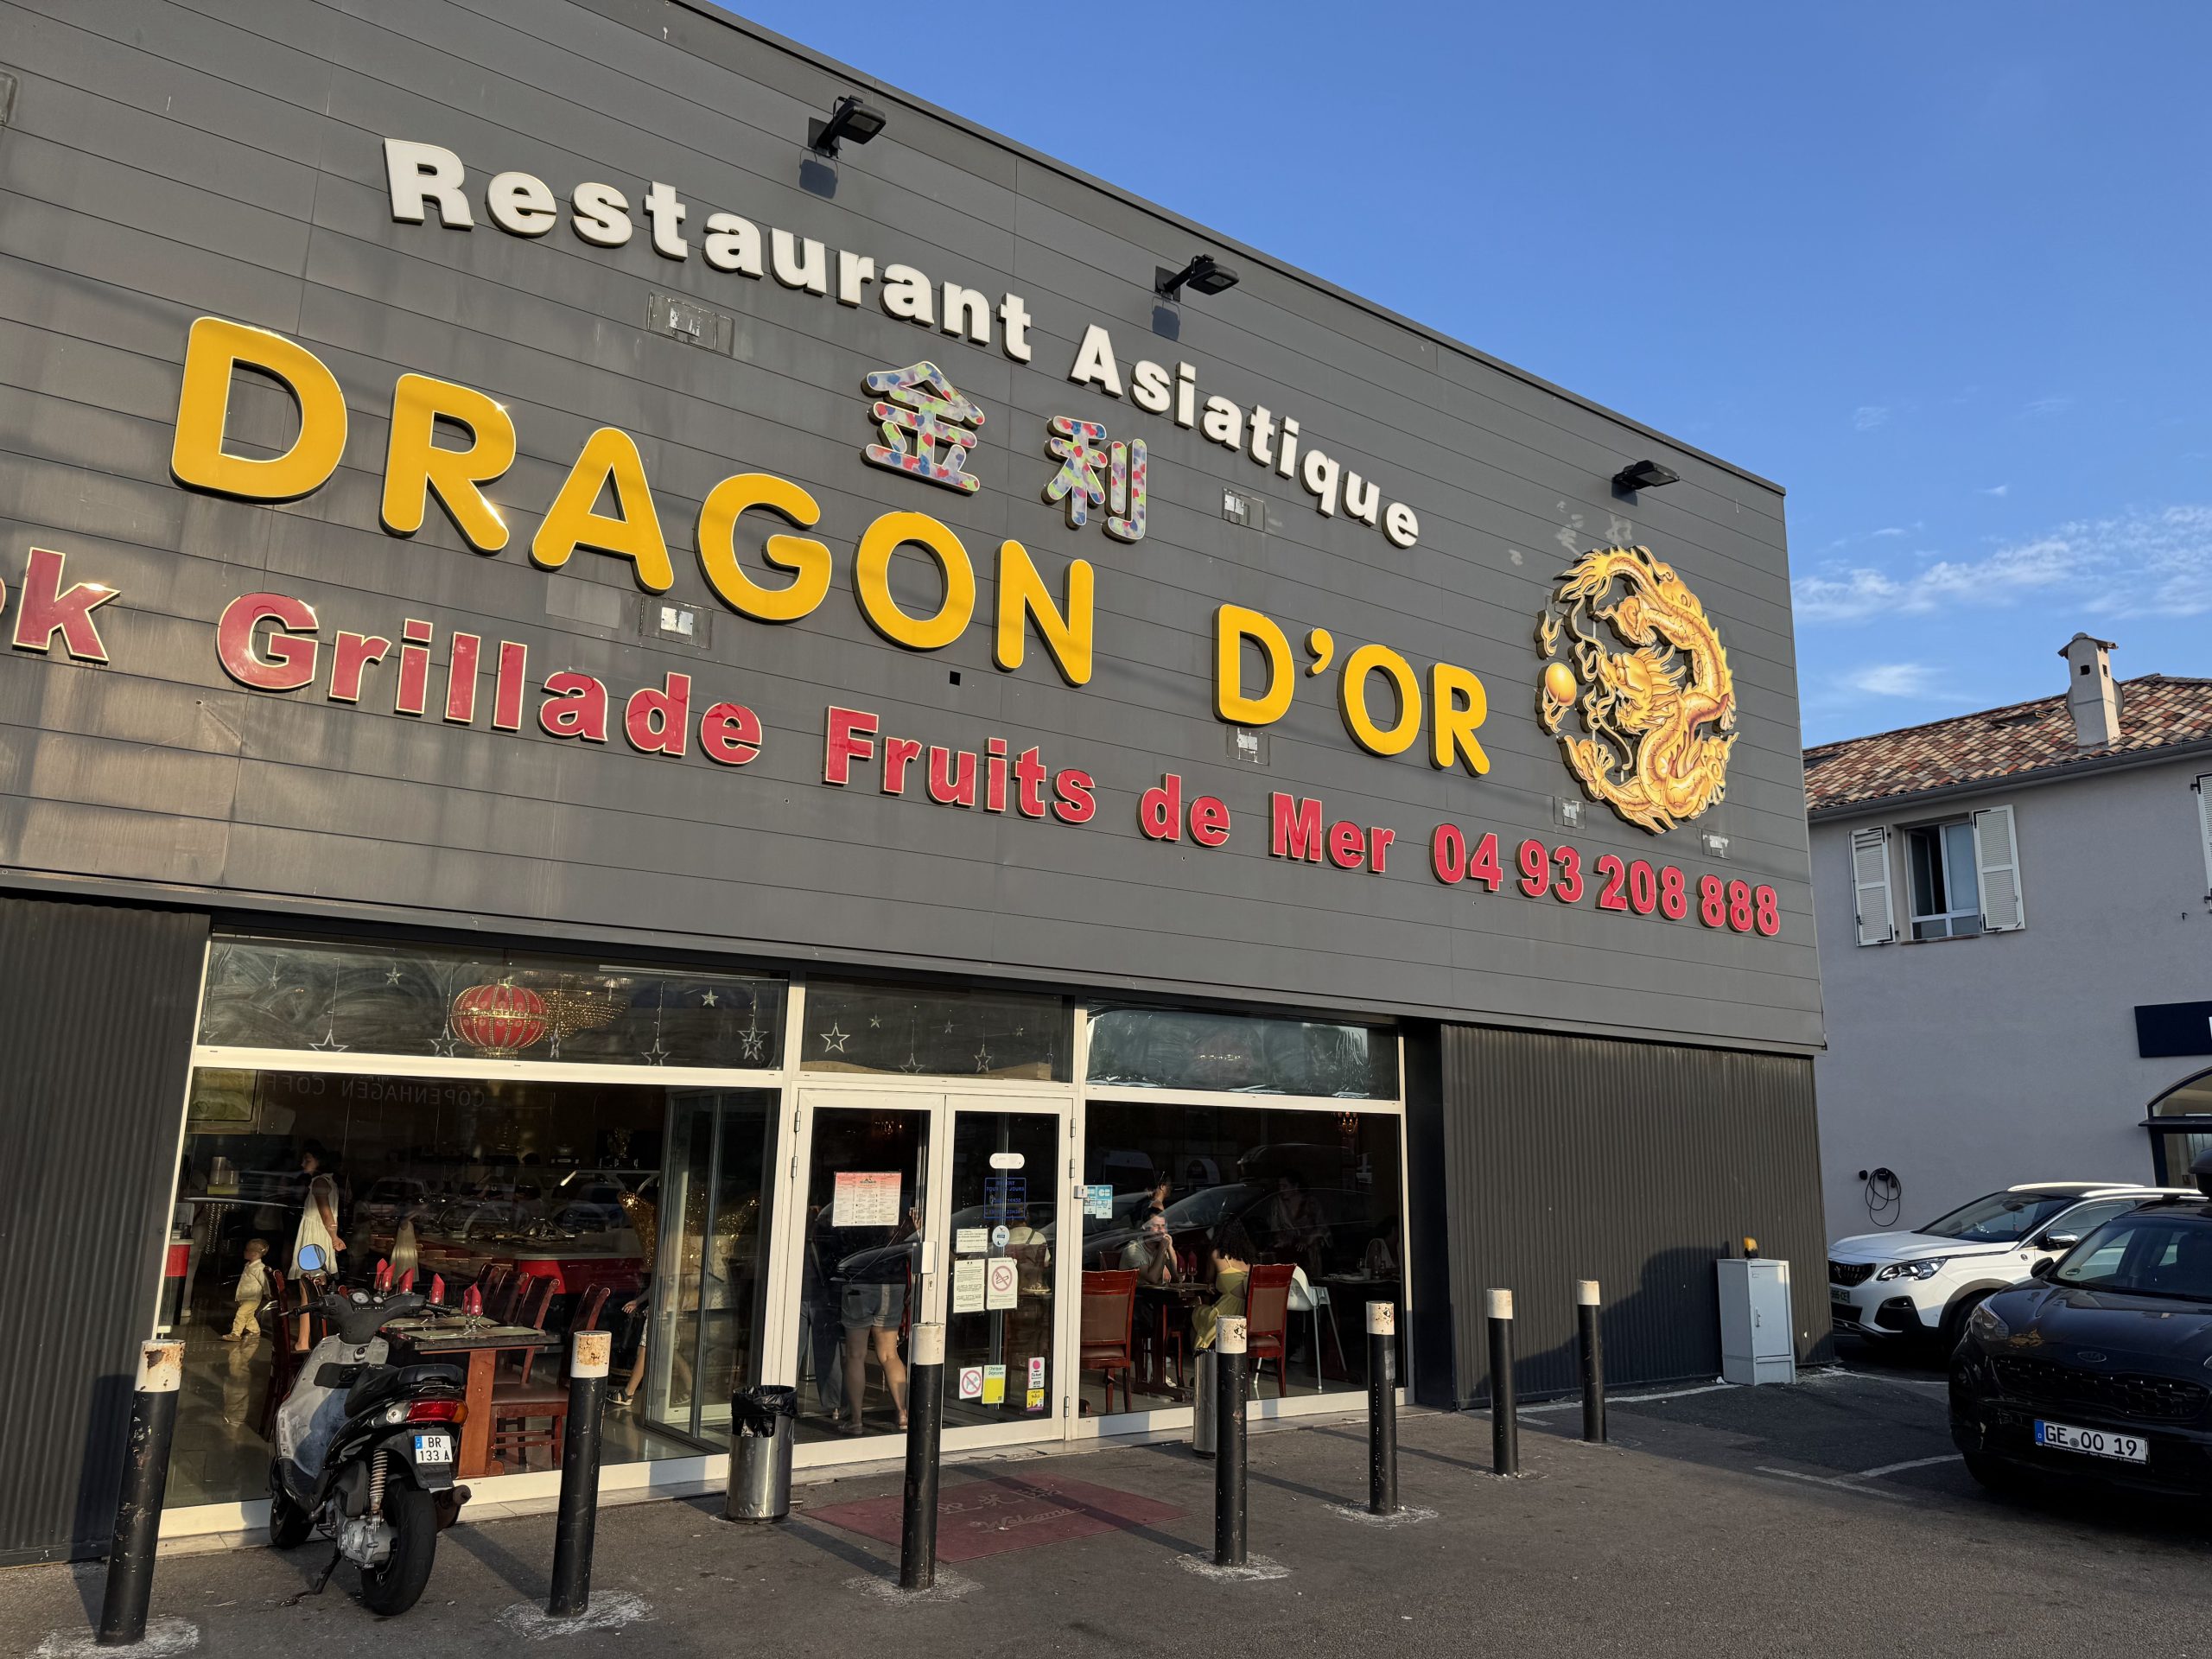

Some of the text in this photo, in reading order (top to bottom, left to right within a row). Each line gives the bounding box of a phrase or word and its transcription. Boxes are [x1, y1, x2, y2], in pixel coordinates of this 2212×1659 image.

[383, 137, 1420, 549] Restaurant Asiatique
[861, 360, 1147, 543] 金利
[170, 315, 1491, 777] DRAGON D'OR
[0, 546, 1781, 937] k Grillade Fruits de Mer 04 93 208 888
[420, 1450, 450, 1461] 133 A
[428, 1437, 442, 1448] BR
[2045, 1425, 2069, 1445] GE
[2113, 1437, 2138, 1457] 19
